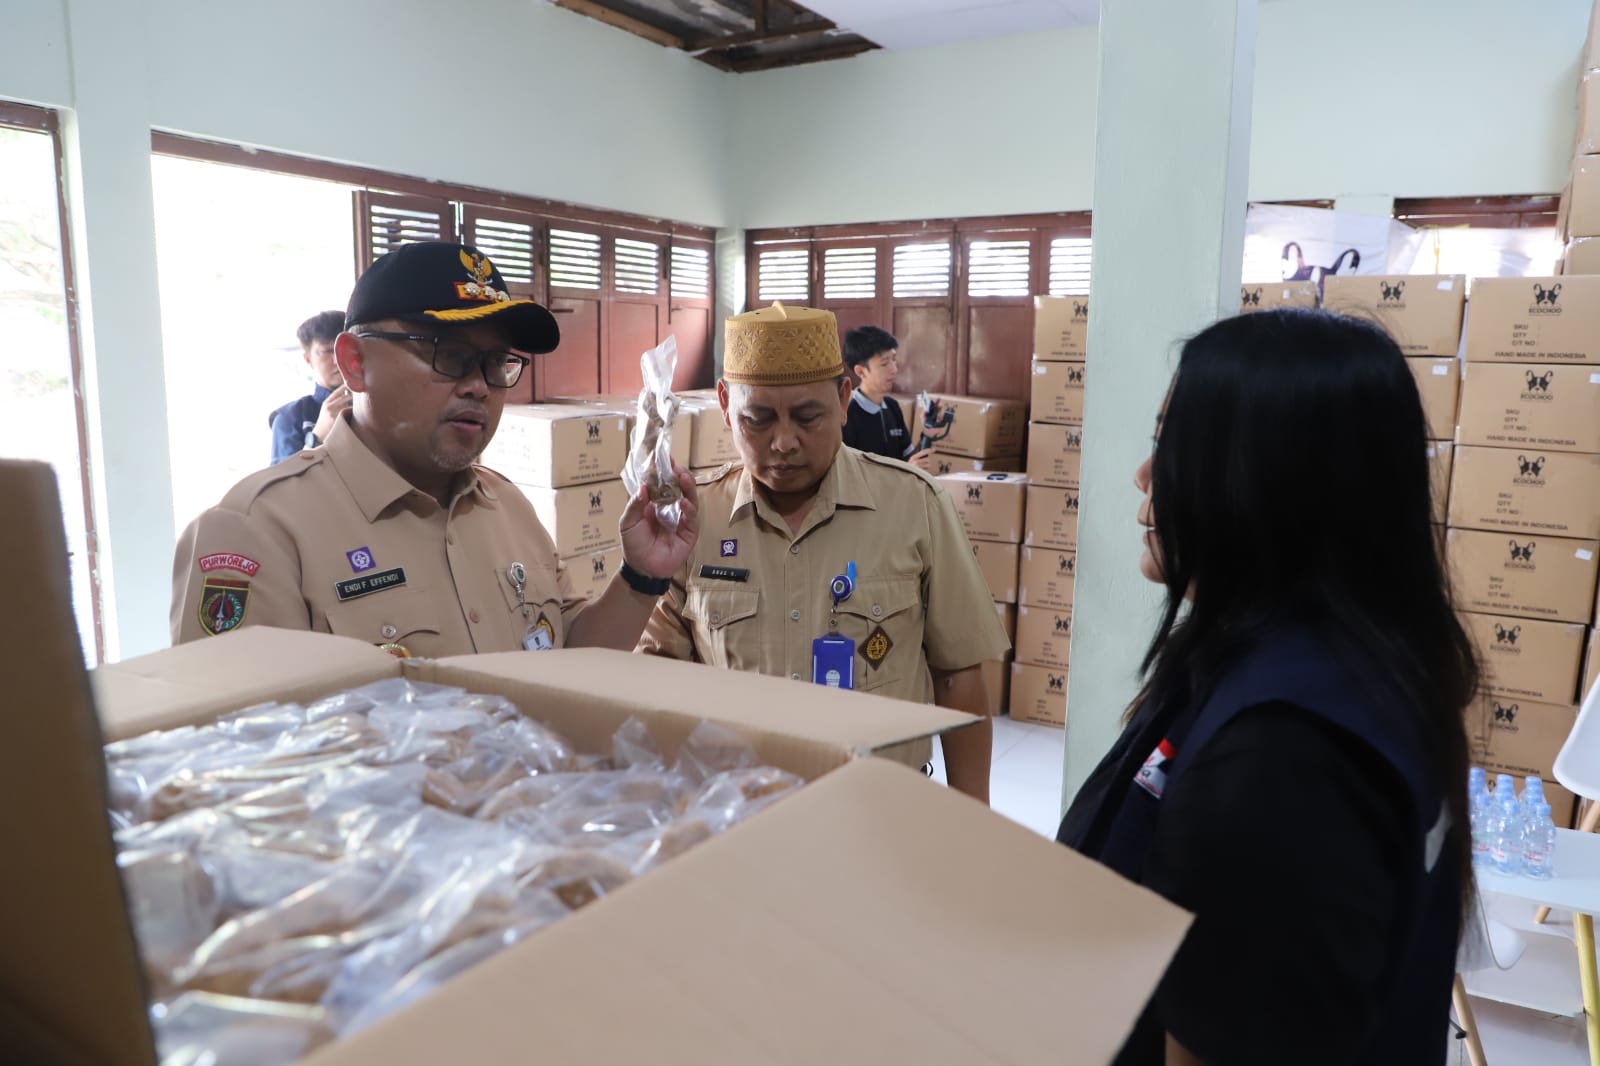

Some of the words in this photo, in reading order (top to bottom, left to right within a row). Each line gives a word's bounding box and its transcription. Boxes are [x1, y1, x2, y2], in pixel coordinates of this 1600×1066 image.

[202, 555, 255, 571] PURWOREJO
[344, 582, 361, 593] ENDI
[370, 572, 399, 587] EFFENDI
